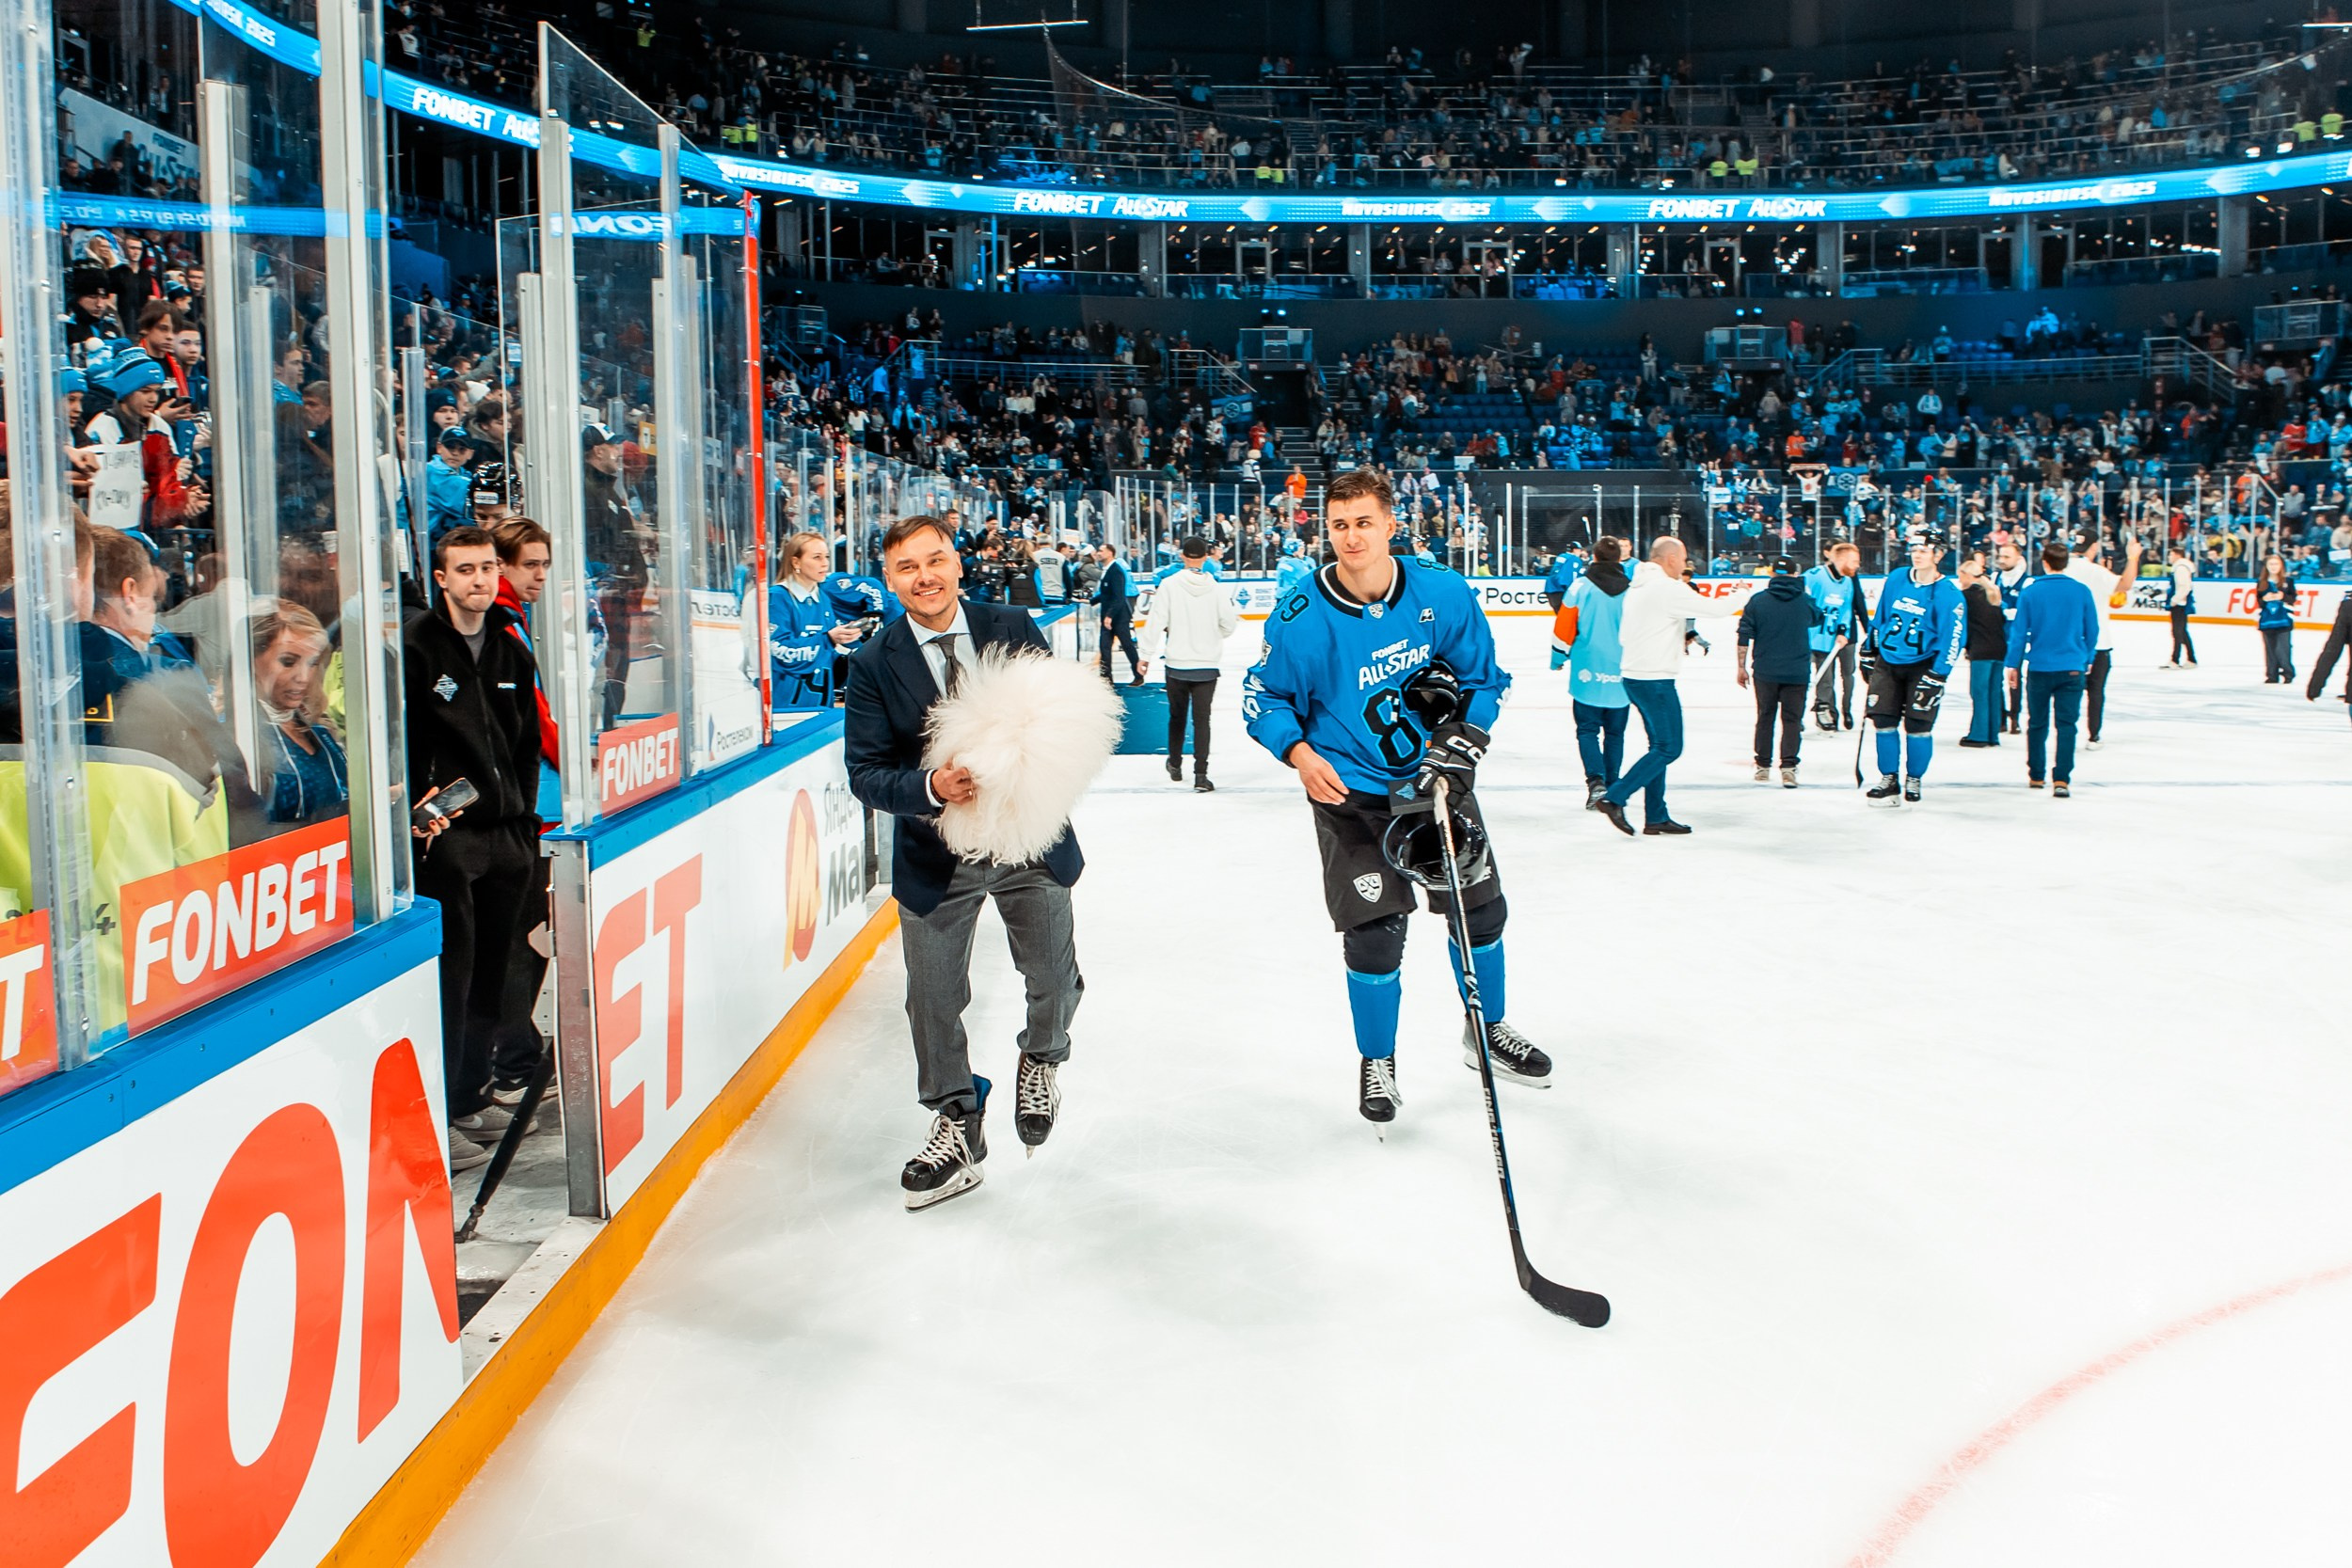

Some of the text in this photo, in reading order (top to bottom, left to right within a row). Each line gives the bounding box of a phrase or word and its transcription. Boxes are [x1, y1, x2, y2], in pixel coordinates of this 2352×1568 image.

[411, 87, 496, 132] FONBET
[1013, 192, 1104, 214] FONBET
[1648, 198, 1740, 218] FONBET
[1882, 613, 1924, 655] 24
[602, 726, 679, 803] FONBET
[131, 839, 347, 1006] FONBET
